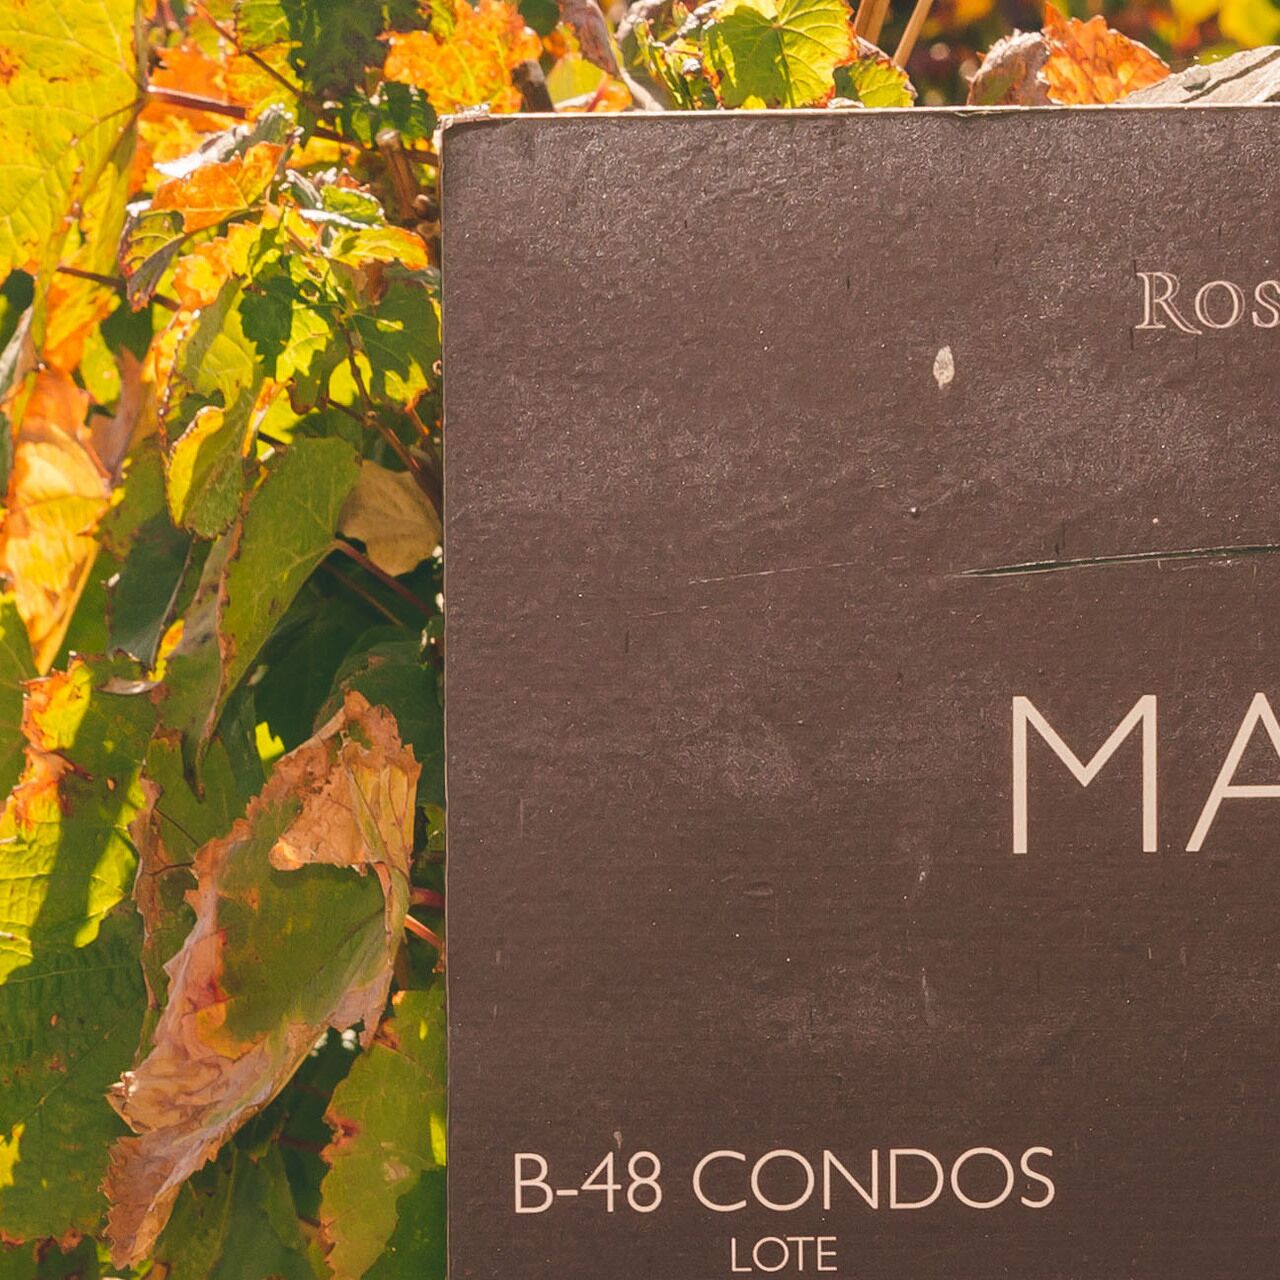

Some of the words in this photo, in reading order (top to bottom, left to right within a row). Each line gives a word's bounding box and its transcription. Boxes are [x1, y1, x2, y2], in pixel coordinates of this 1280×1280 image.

[513, 1149, 663, 1215] B-48
[691, 1145, 1056, 1213] CONDOS
[730, 1235, 839, 1273] LOTE
